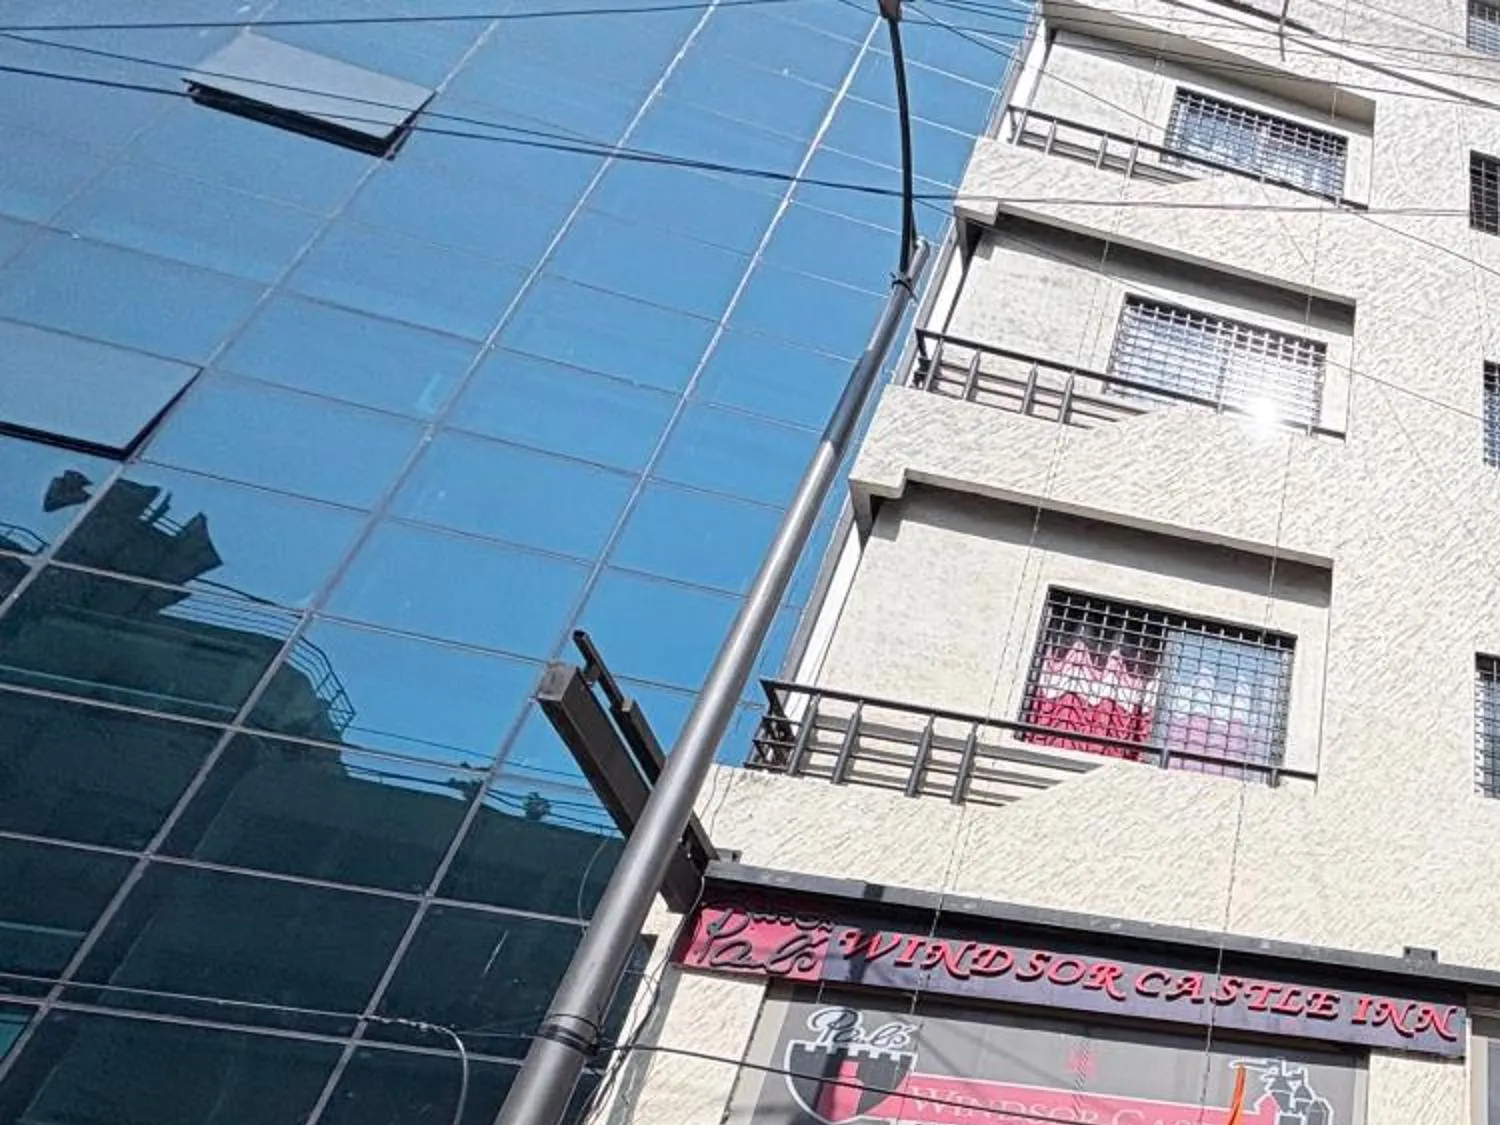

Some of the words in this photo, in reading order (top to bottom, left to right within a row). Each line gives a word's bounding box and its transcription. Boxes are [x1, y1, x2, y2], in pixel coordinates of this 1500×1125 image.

[839, 927, 1127, 999] WINDSOR
[1135, 970, 1340, 1020] CASTLE
[1351, 997, 1458, 1042] INN
